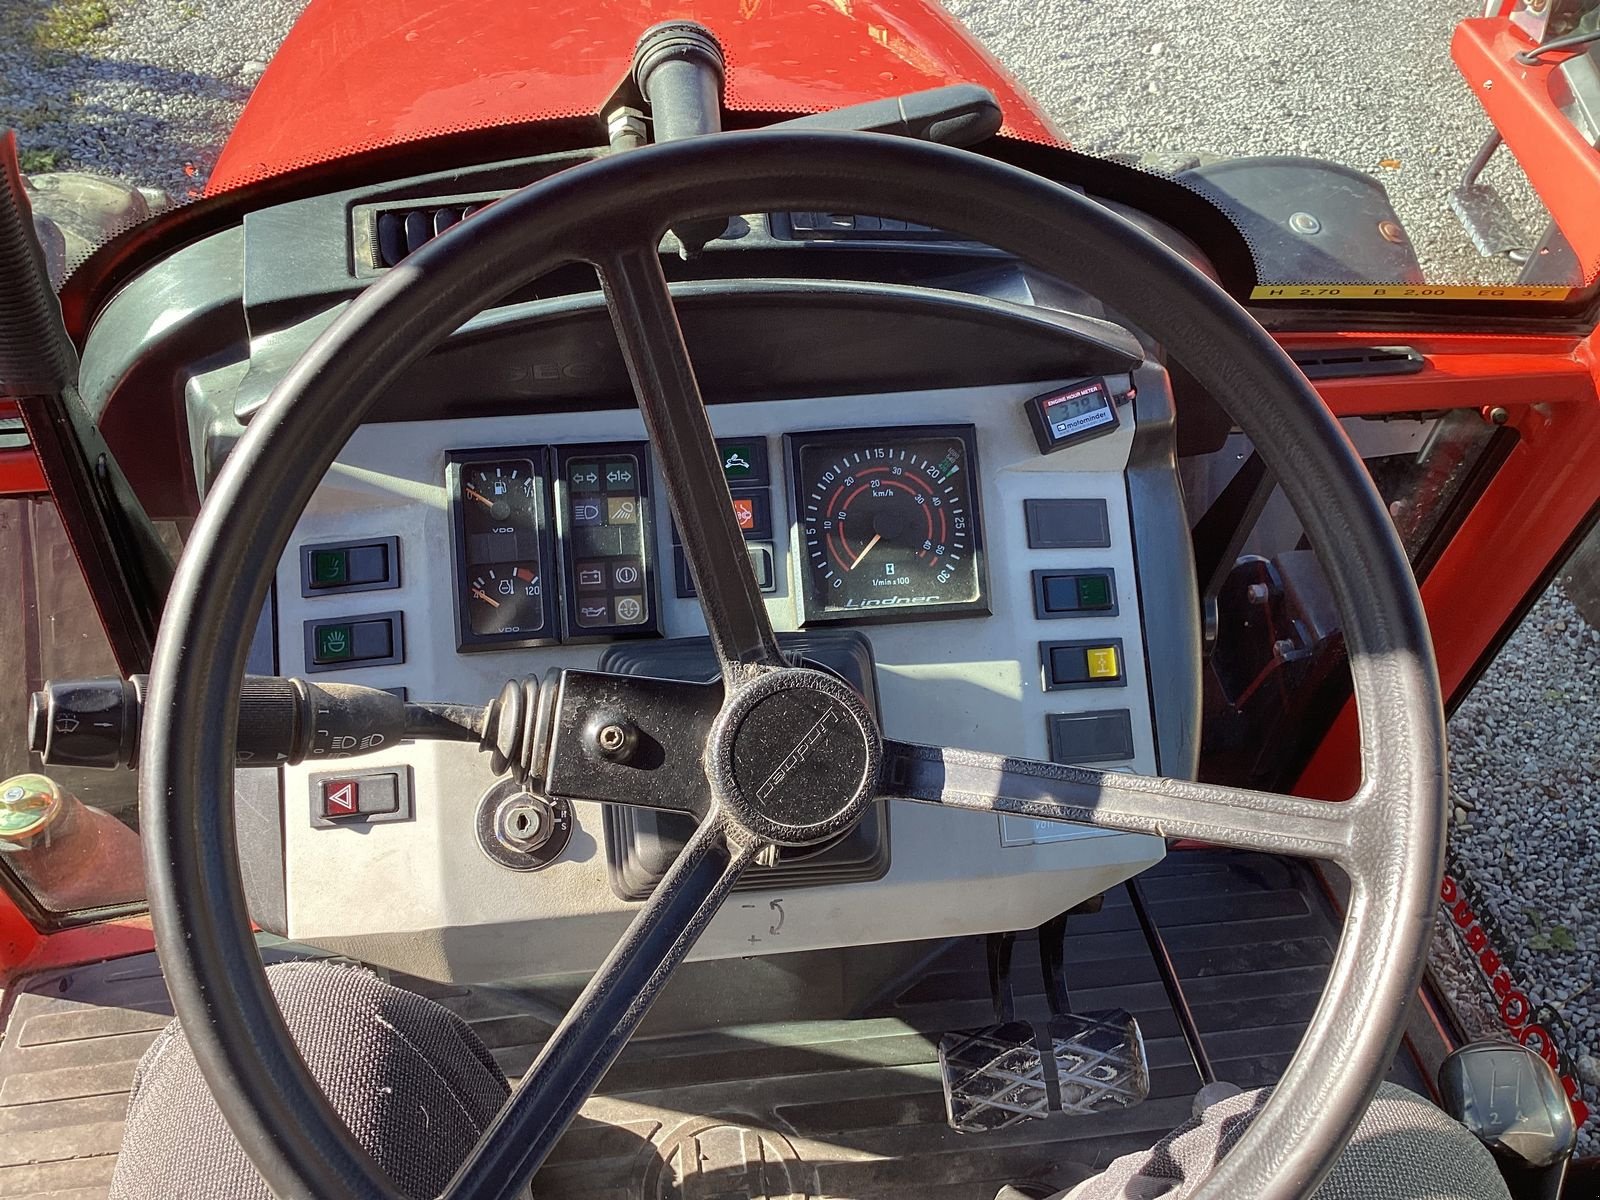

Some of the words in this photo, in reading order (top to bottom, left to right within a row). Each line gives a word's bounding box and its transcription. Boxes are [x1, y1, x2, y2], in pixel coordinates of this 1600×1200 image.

[1478, 289, 1504, 297] EG
[874, 448, 885, 458] 15
[892, 466, 902, 475] 30
[926, 465, 940, 479] 20
[822, 471, 835, 484] 10
[844, 476, 855, 487] 20
[870, 479, 881, 488] 20
[872, 489, 894, 497] km/h
[914, 493, 925, 505] 30
[932, 496, 942, 507] 40
[838, 511, 847, 520] 10
[823, 520, 832, 529] 10
[954, 517, 966, 529] 25
[922, 539, 932, 551] 40
[935, 544, 945, 555] 50
[936, 569, 951, 584] 30
[833, 578, 842, 588] 0
[525, 586, 540, 596] 120
[845, 595, 940, 608] Lindner
[761, 707, 839, 800] Lindner
[1489, 1112, 1502, 1124] 2
